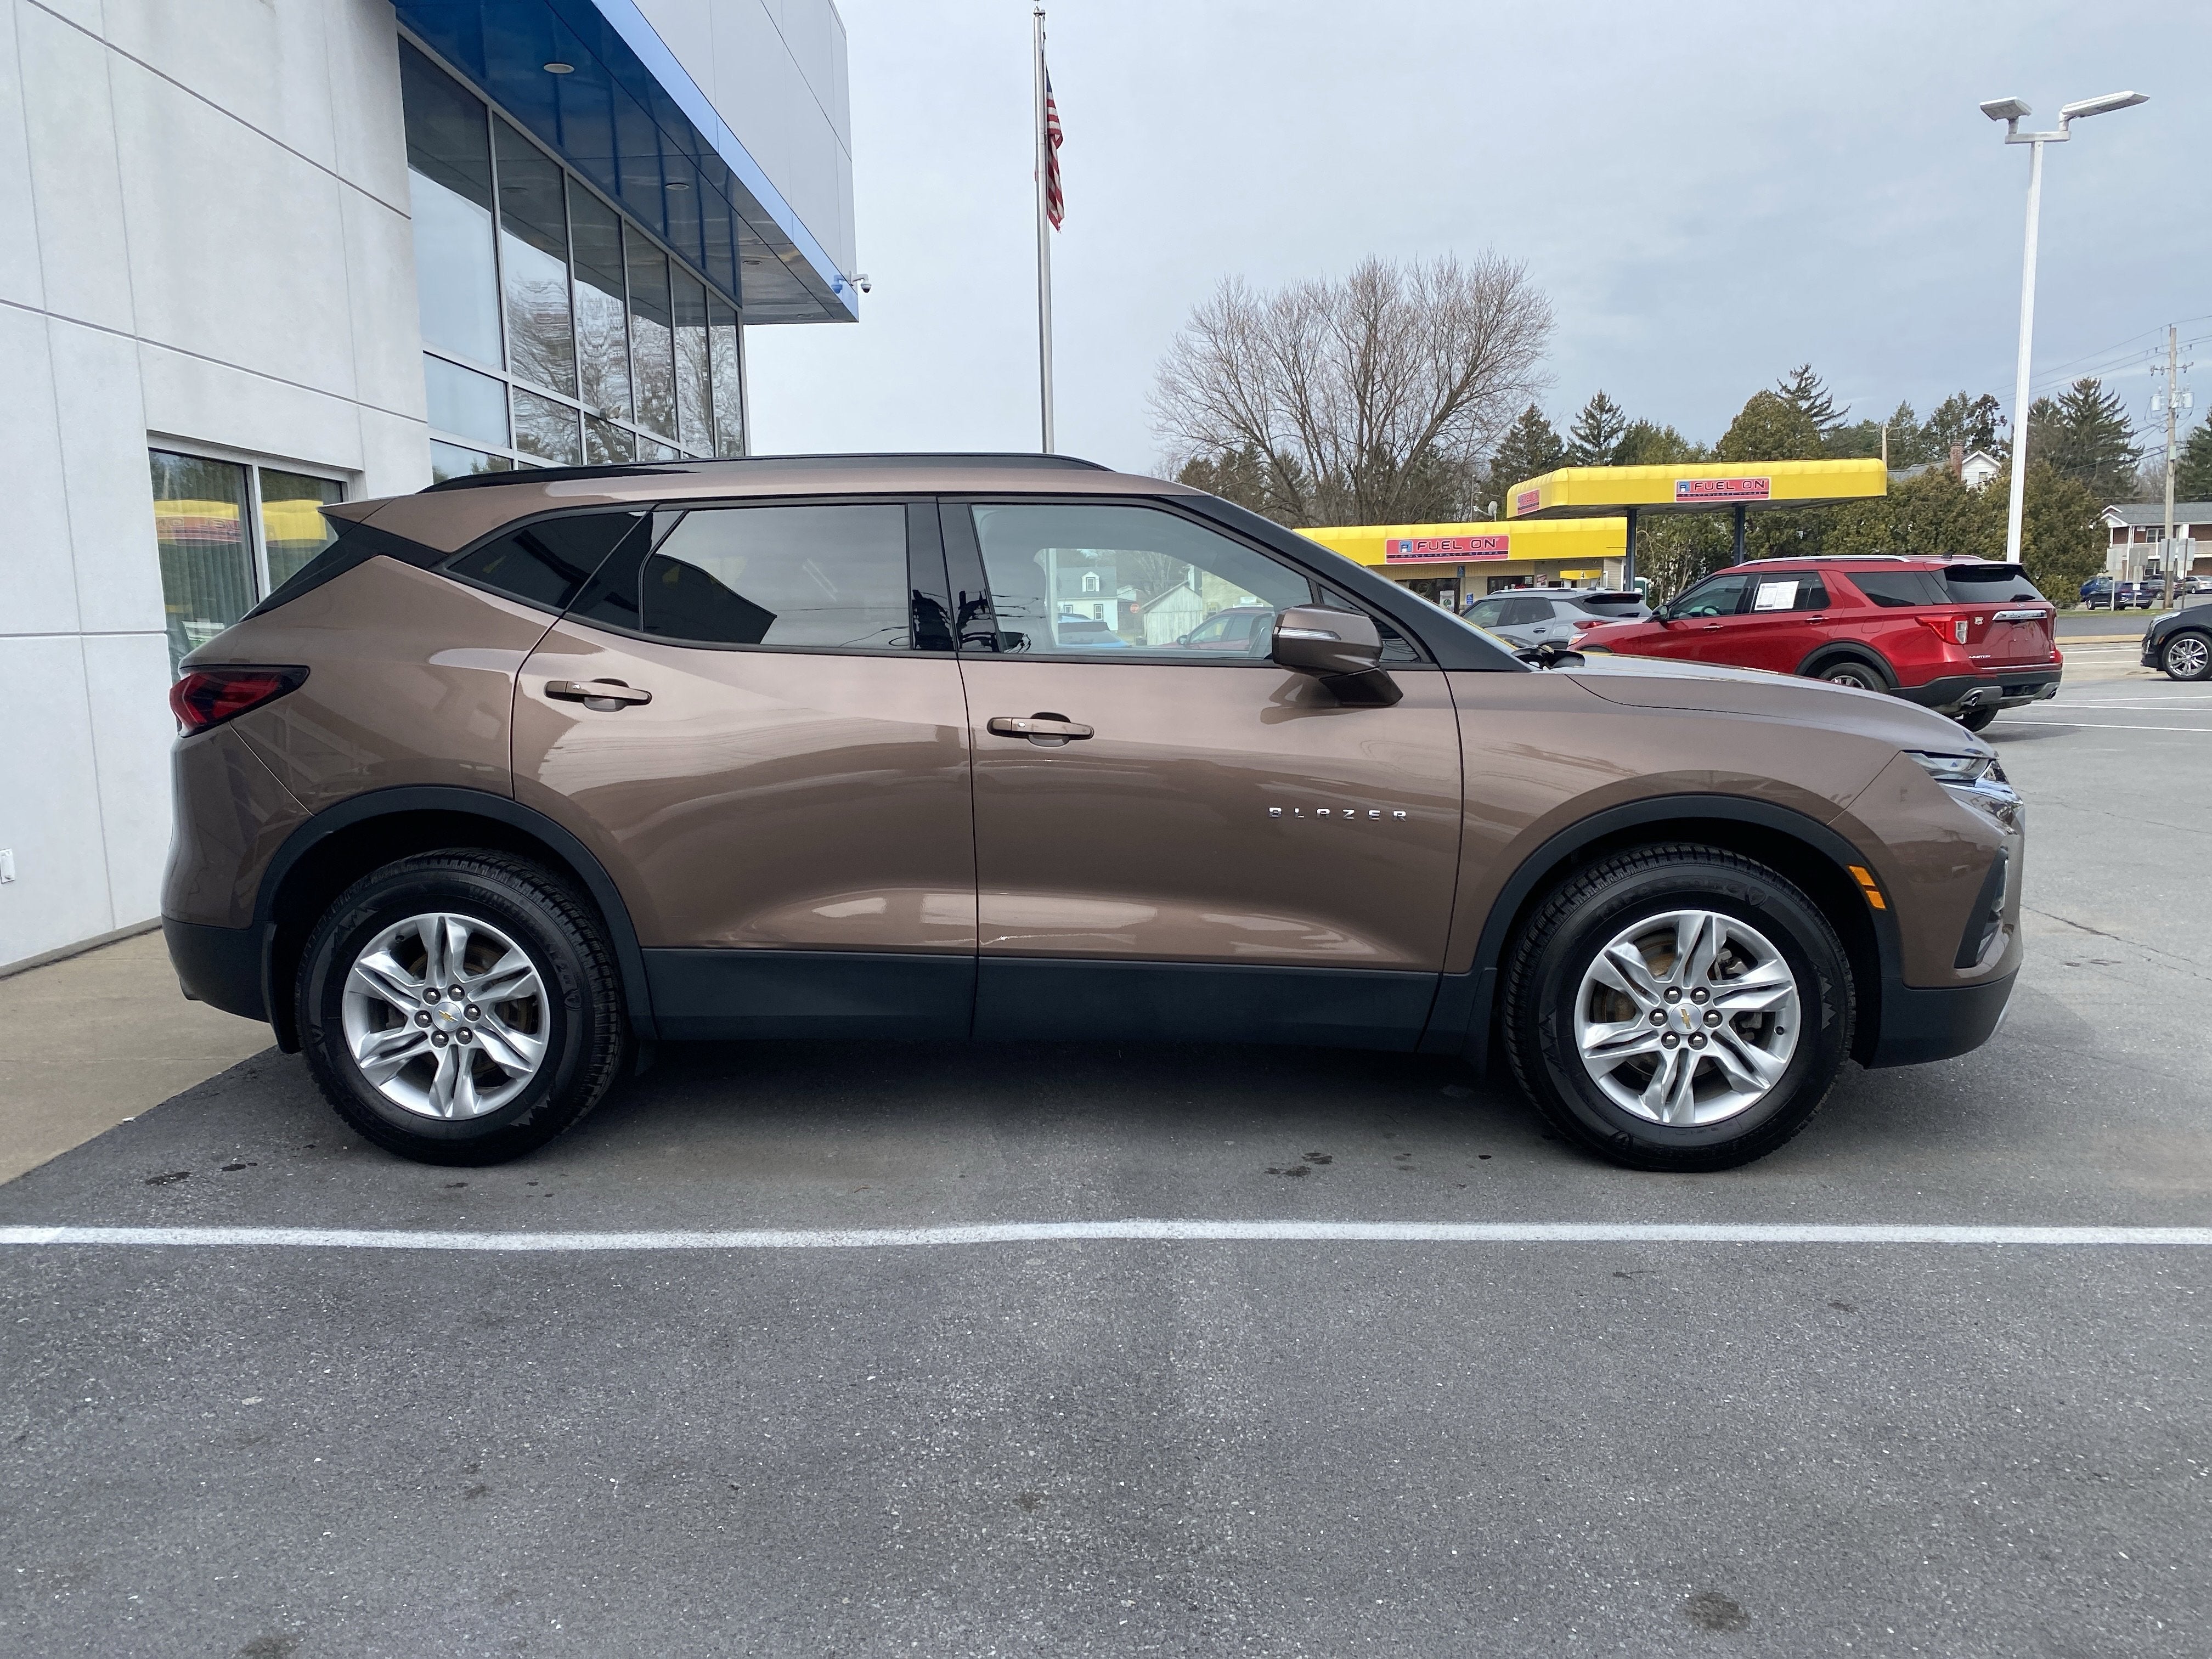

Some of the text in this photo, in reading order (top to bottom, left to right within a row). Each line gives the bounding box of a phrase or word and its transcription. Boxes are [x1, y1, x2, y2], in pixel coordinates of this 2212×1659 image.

[1694, 480, 1765, 491] FUEL ON
[1417, 538, 1496, 551] FUEL ON
[1268, 807, 1407, 822] BLAZER
